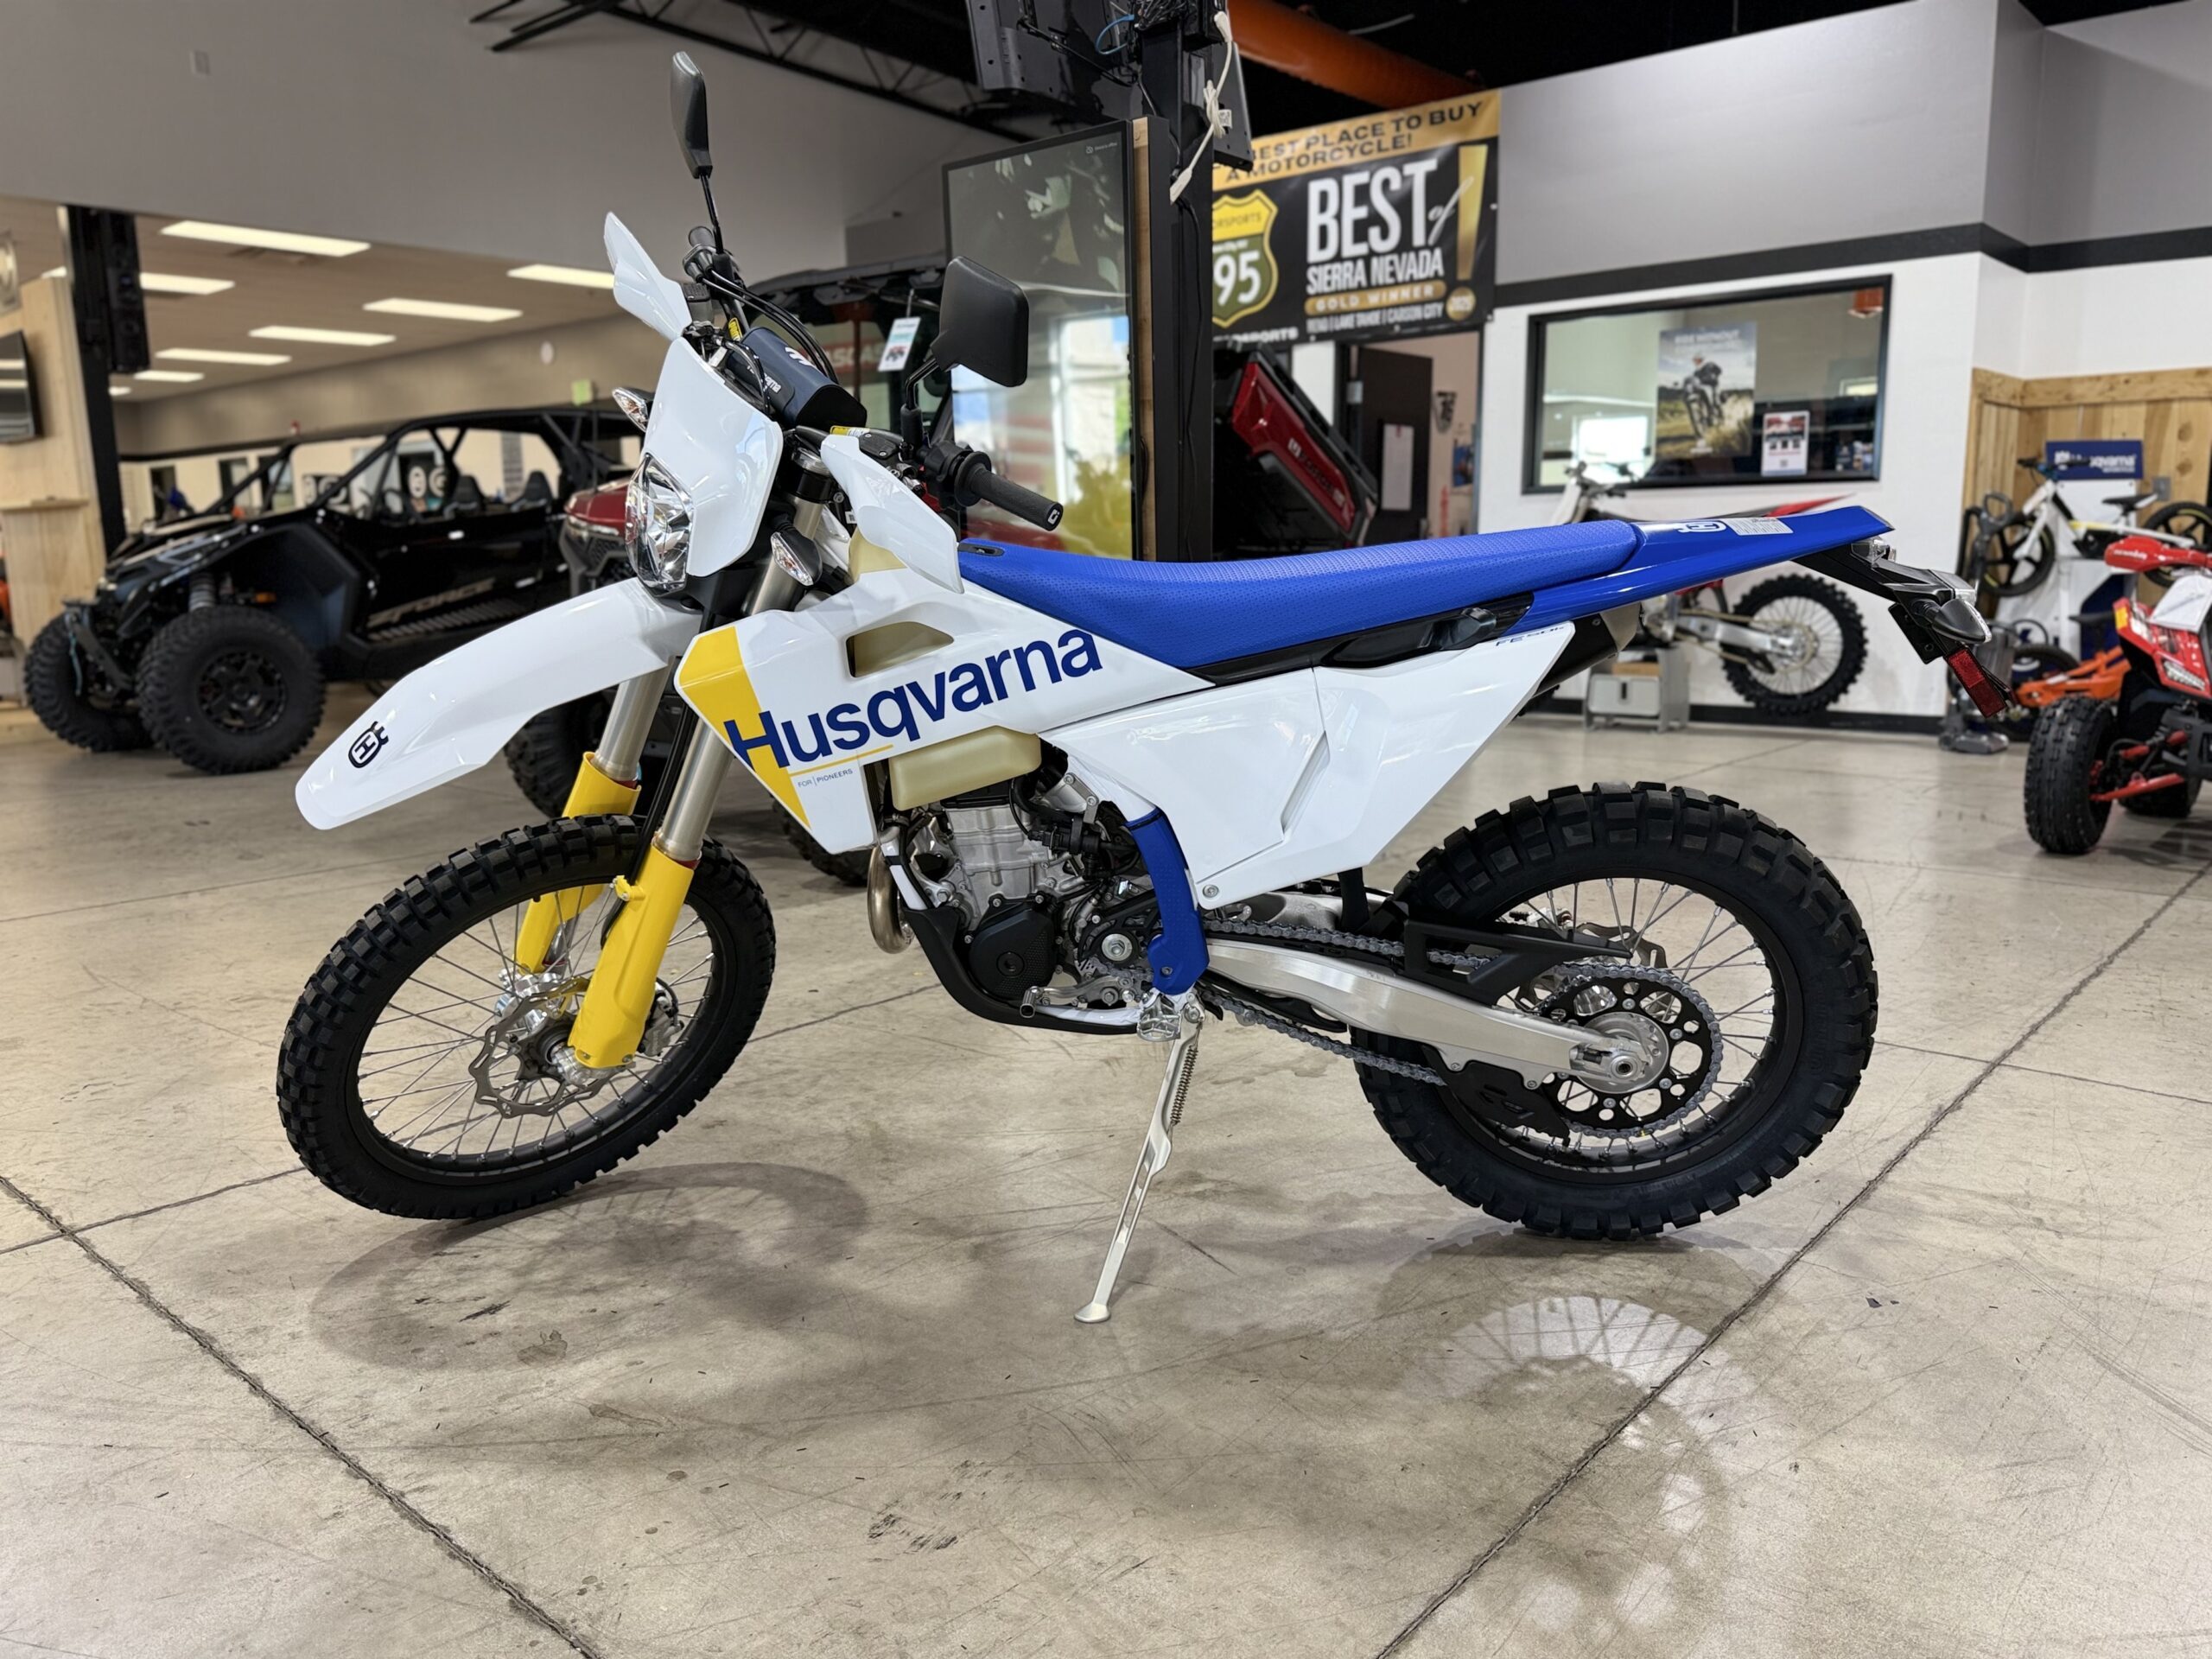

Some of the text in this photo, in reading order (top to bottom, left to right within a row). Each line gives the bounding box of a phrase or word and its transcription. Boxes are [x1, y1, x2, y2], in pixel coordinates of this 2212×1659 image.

[1253, 101, 1484, 161] EST PLACE TO BUY
[1226, 134, 1413, 183] A MOTORCYCLE!
[1306, 158, 1475, 264] BEST of
[1213, 251, 1262, 307] 95
[1306, 247, 1444, 295] SIERRA NEVADA
[1315, 284, 1434, 312] GOLD WINNER
[1423, 302, 1445, 319] CITY
[723, 629, 1103, 774] Husqvarna
[798, 768, 854, 788] FOR PIONEERS
